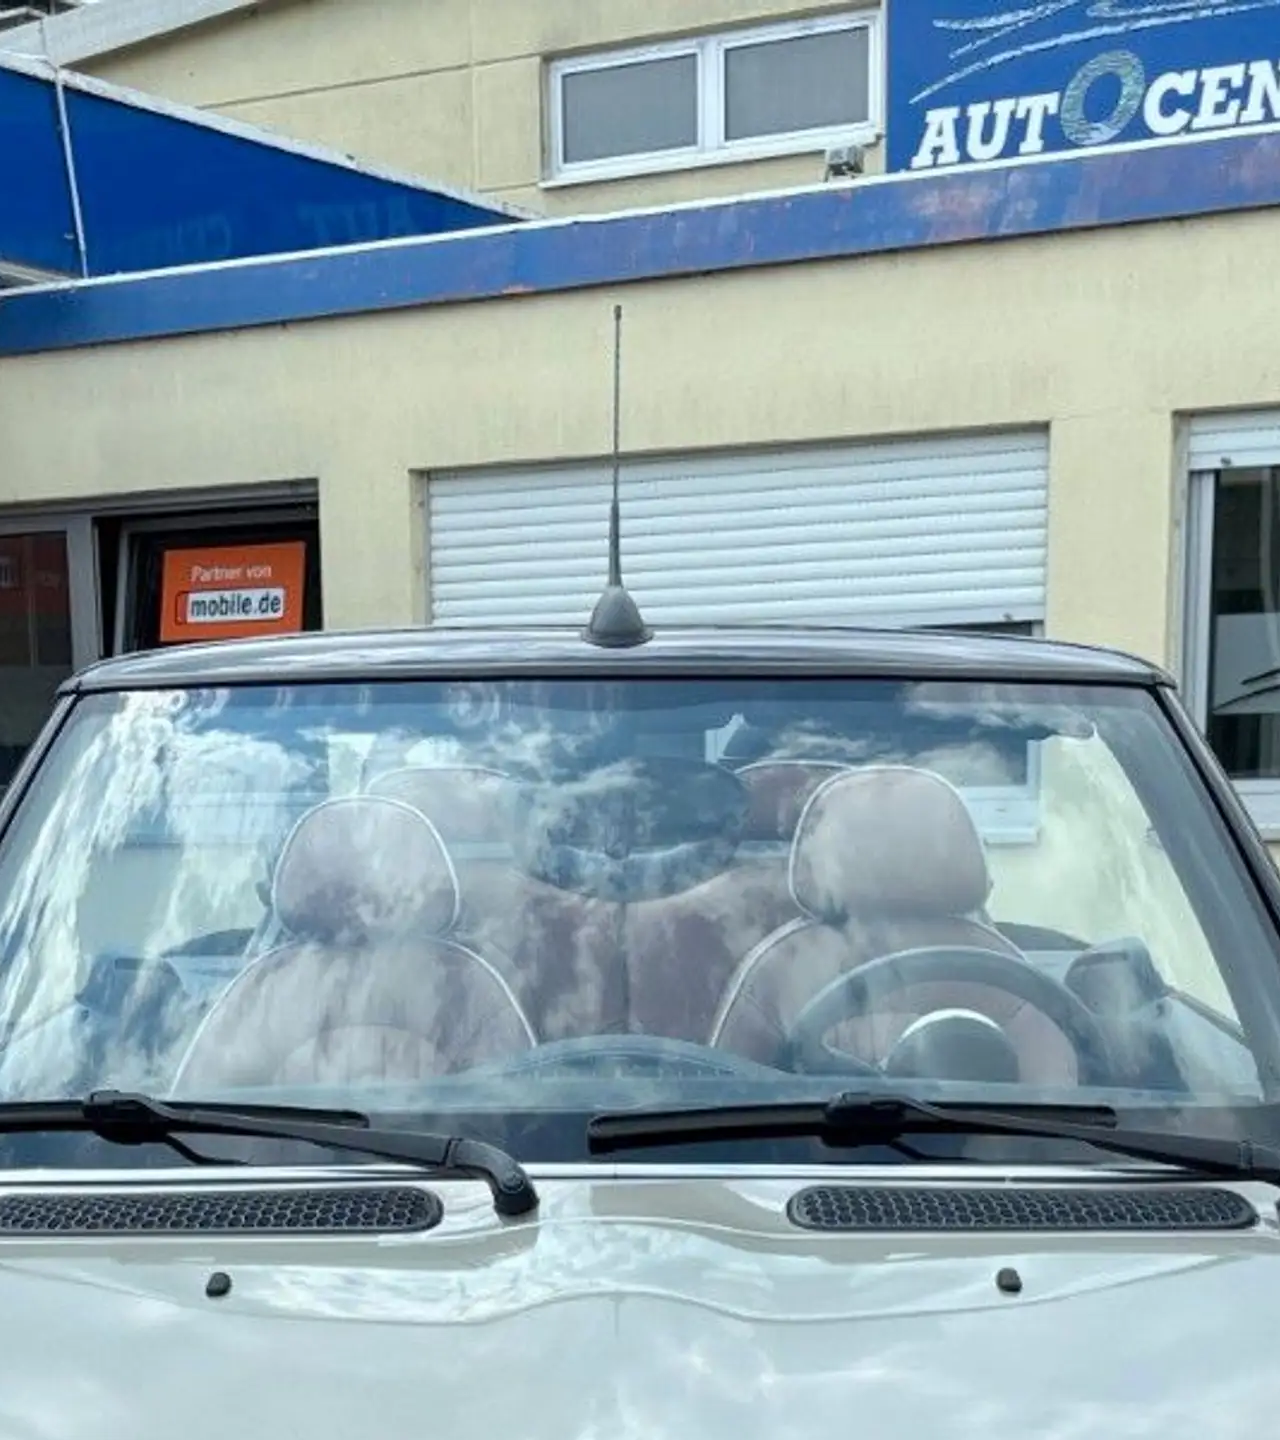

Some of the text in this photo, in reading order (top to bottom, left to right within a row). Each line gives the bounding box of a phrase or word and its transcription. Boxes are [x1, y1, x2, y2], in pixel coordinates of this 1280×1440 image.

[190, 565, 272, 582] Partner von
[190, 592, 281, 617] mobile.de
